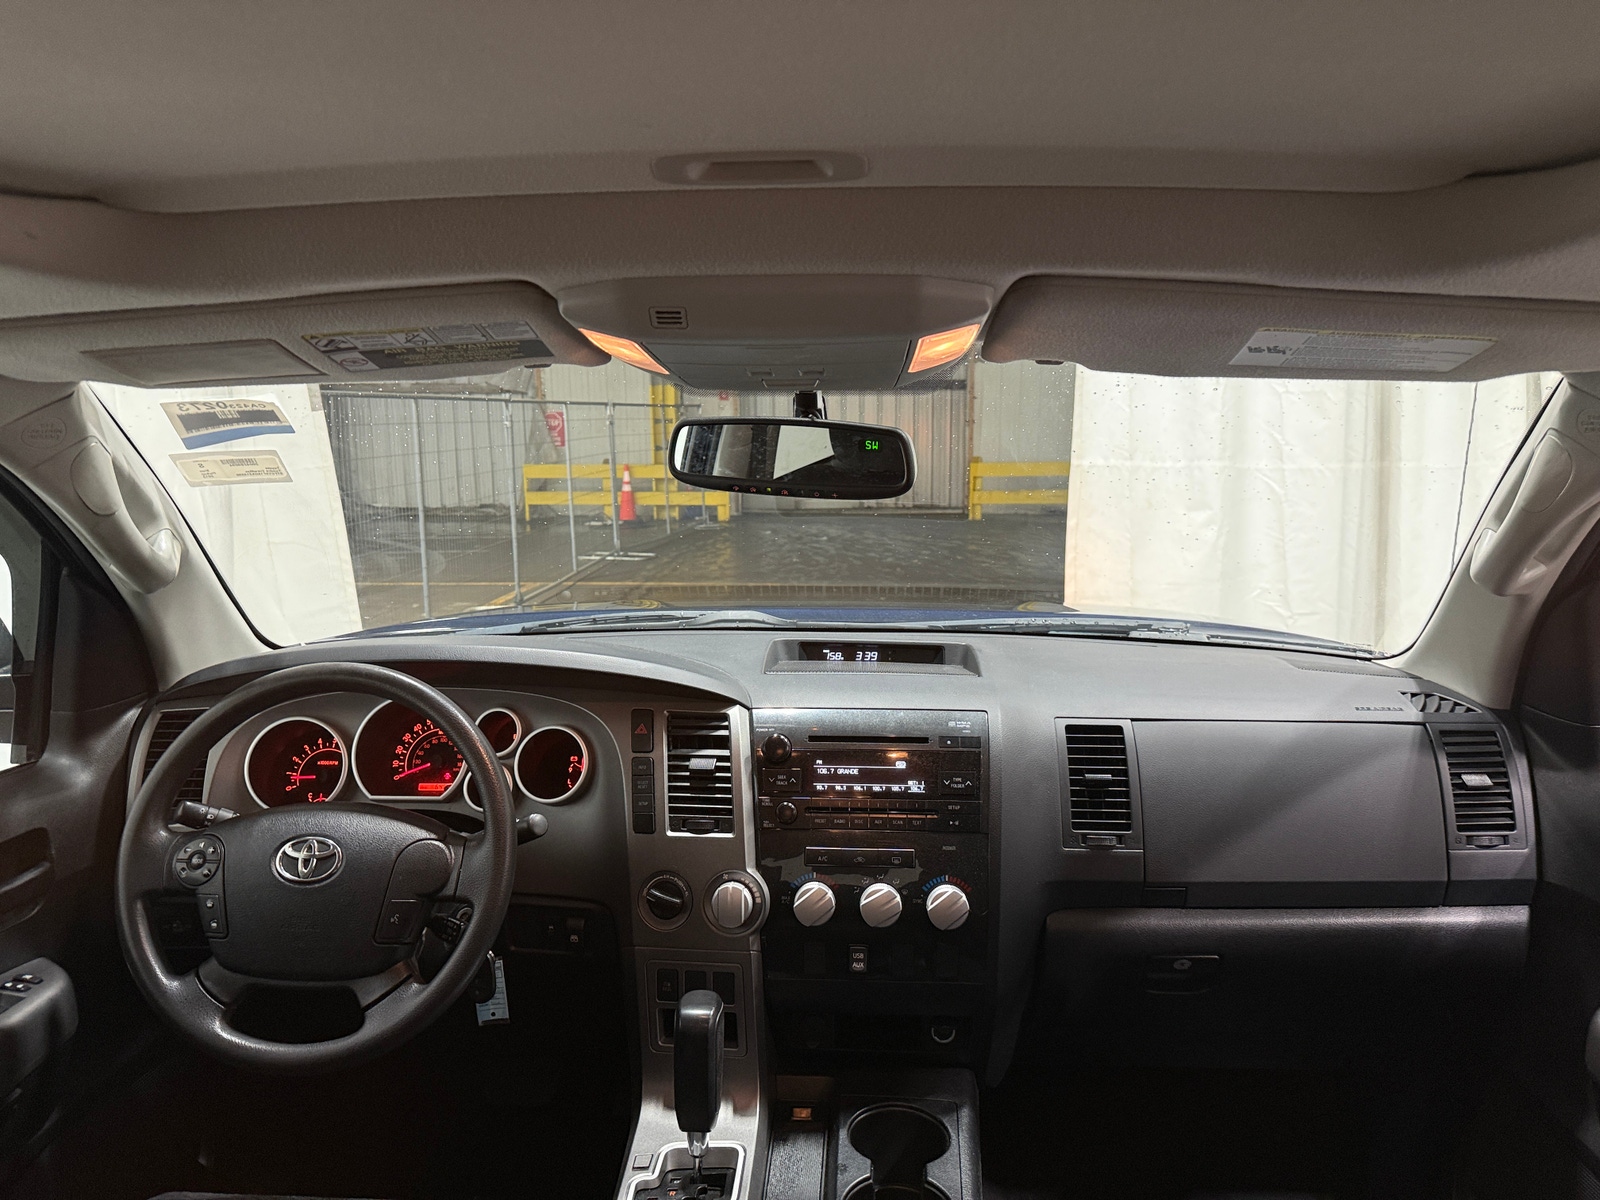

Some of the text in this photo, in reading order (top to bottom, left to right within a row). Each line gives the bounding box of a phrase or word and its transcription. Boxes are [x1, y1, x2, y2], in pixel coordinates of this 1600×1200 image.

[865, 441, 879, 450] SW
[413, 723, 422, 732] 40
[402, 733, 411, 742] 30
[395, 745, 403, 754] 20
[392, 759, 400, 768] 10
